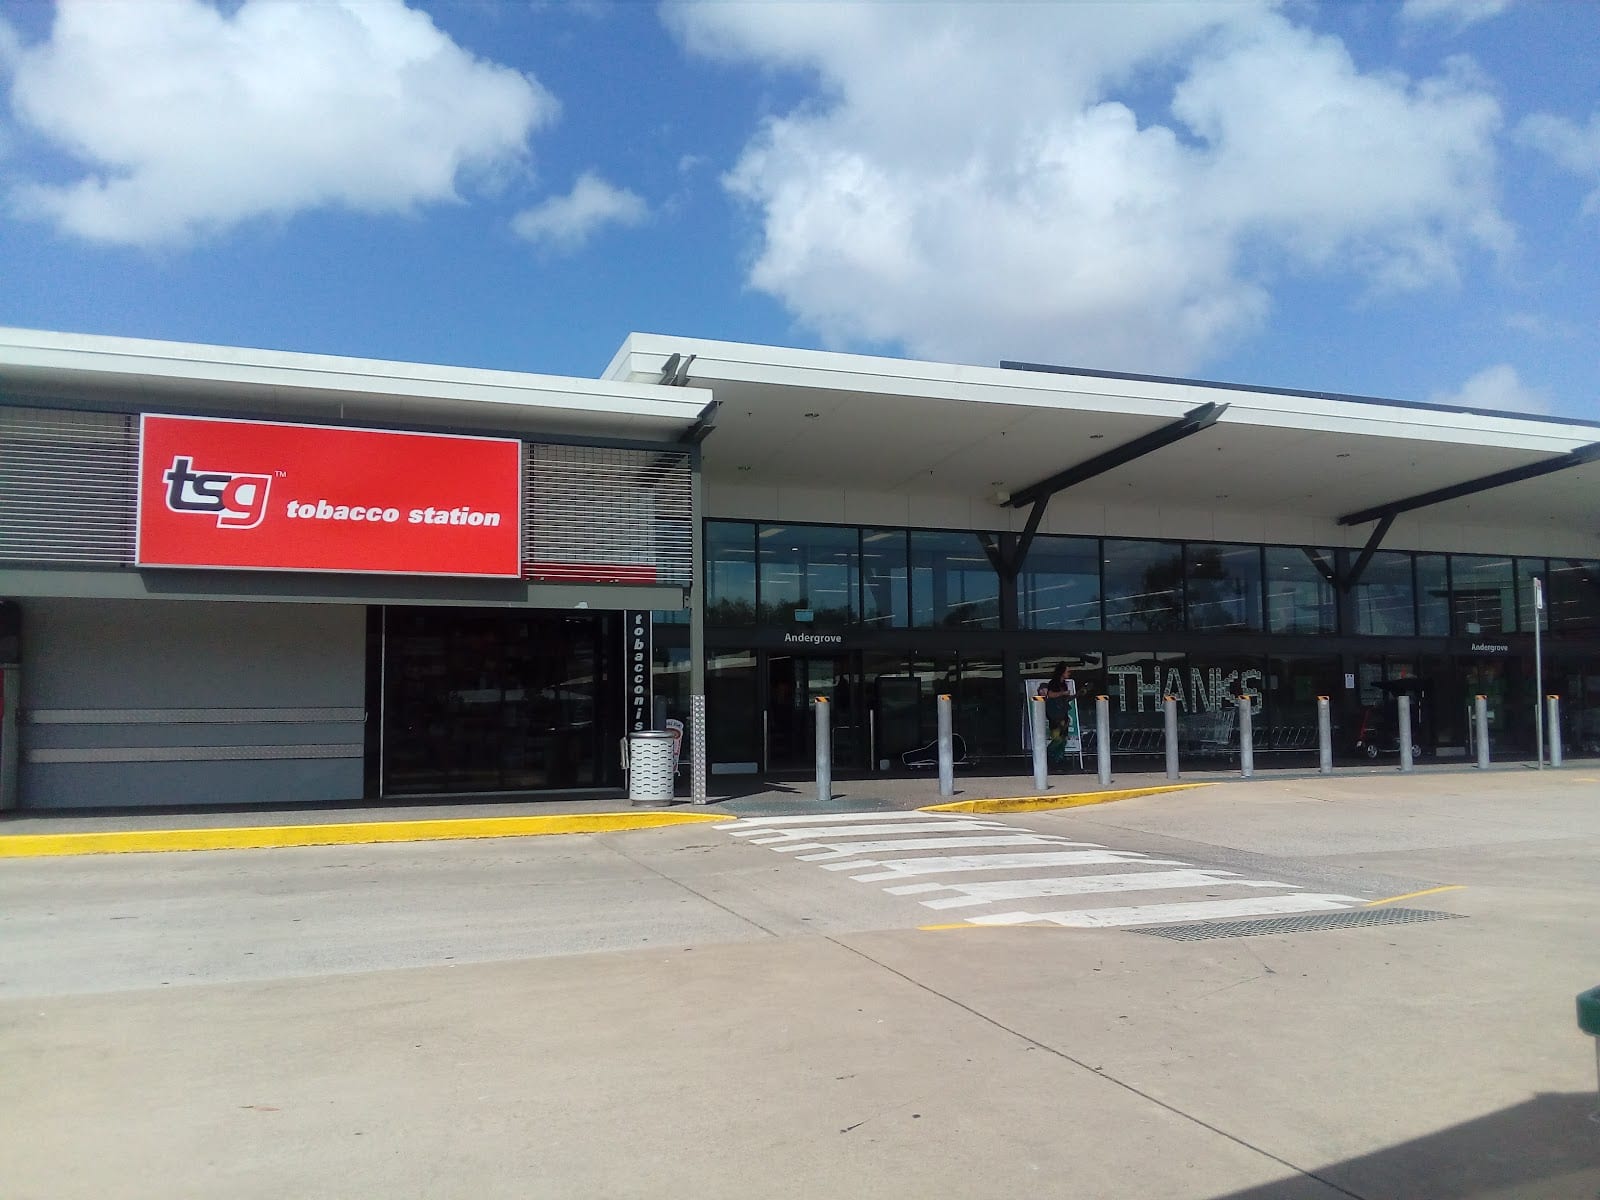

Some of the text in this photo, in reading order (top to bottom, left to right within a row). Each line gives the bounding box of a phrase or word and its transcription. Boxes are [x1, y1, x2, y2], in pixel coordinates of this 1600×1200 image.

[274, 470, 287, 478] TM
[162, 455, 273, 529] tsg
[286, 500, 500, 527] tobacco station
[784, 632, 842, 645] Andergrove
[1471, 643, 1508, 653] Andergrove
[633, 614, 644, 731] tobacconis
[1107, 665, 1263, 715] THANKS
